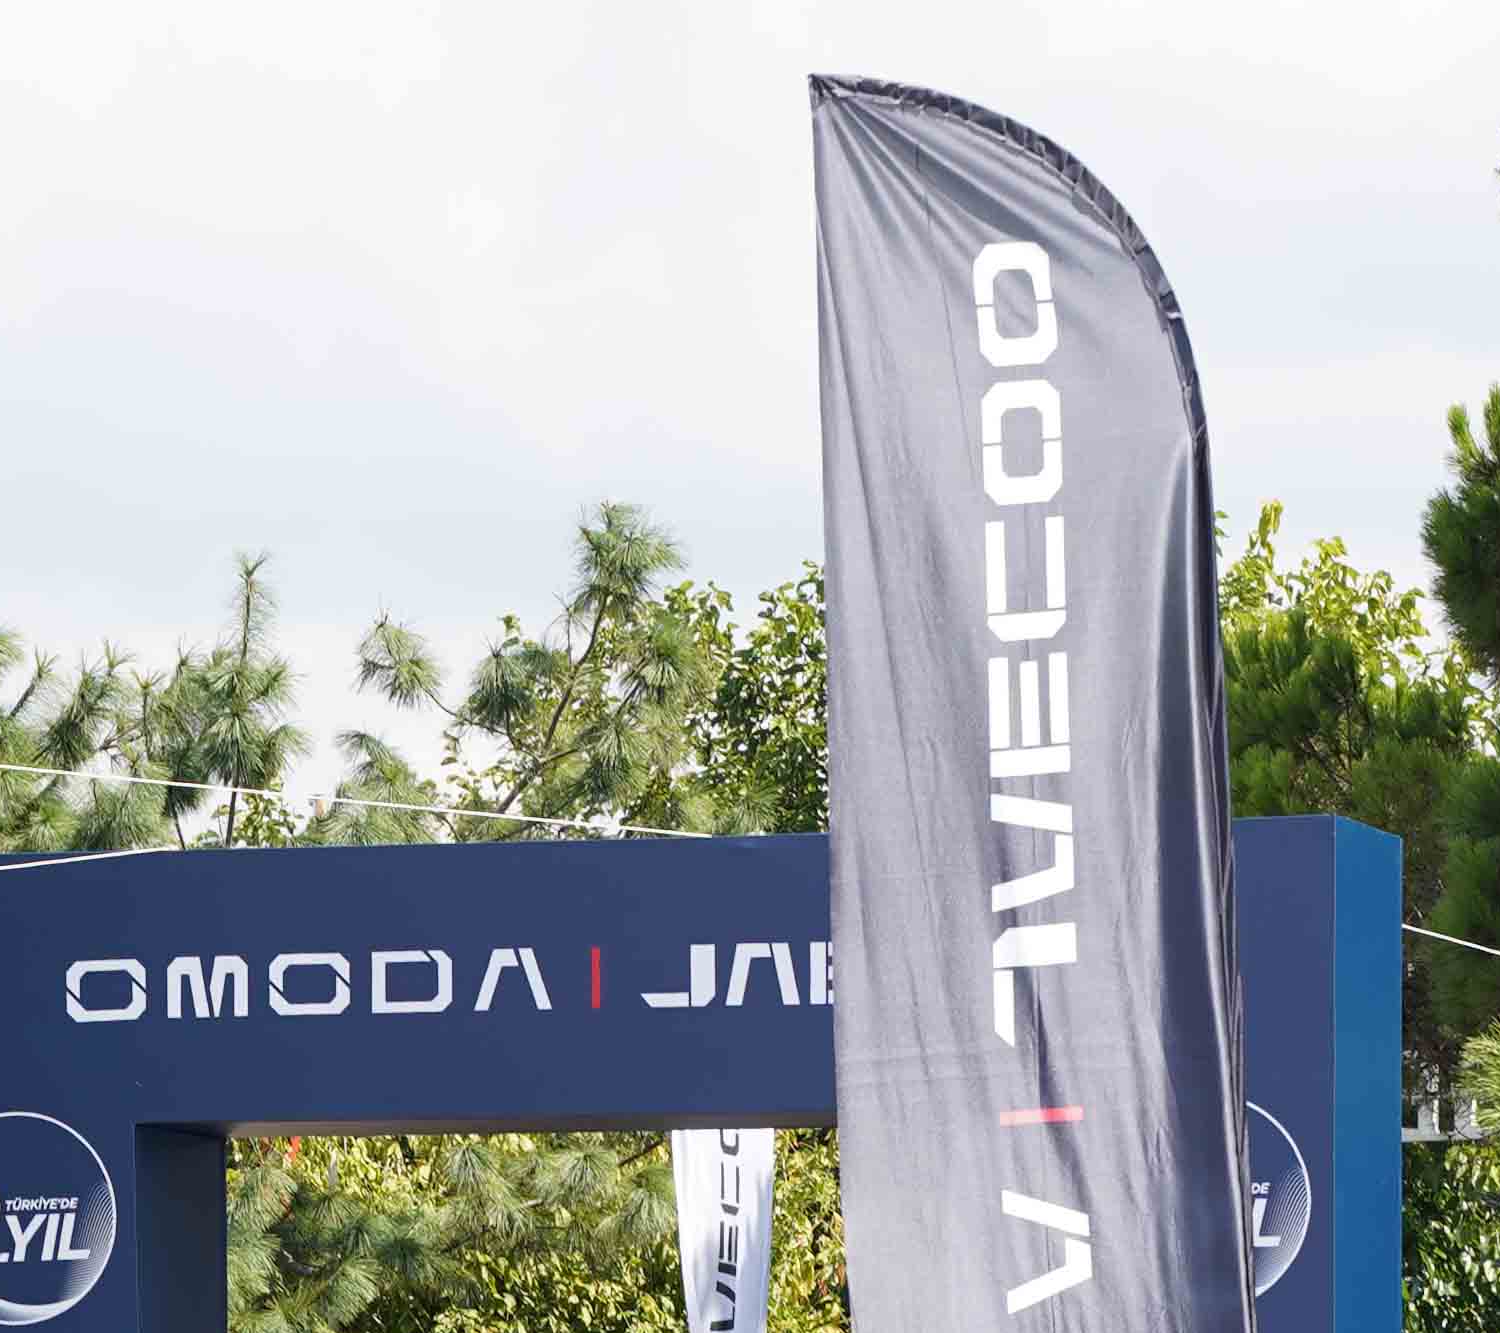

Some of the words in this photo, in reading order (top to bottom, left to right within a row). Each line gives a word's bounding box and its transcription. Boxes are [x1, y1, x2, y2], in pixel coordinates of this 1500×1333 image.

[972, 240, 1079, 1047] JAECOO
[65, 946, 553, 1024] OMODA
[4, 1196, 79, 1211] TÜRKİYE'DE
